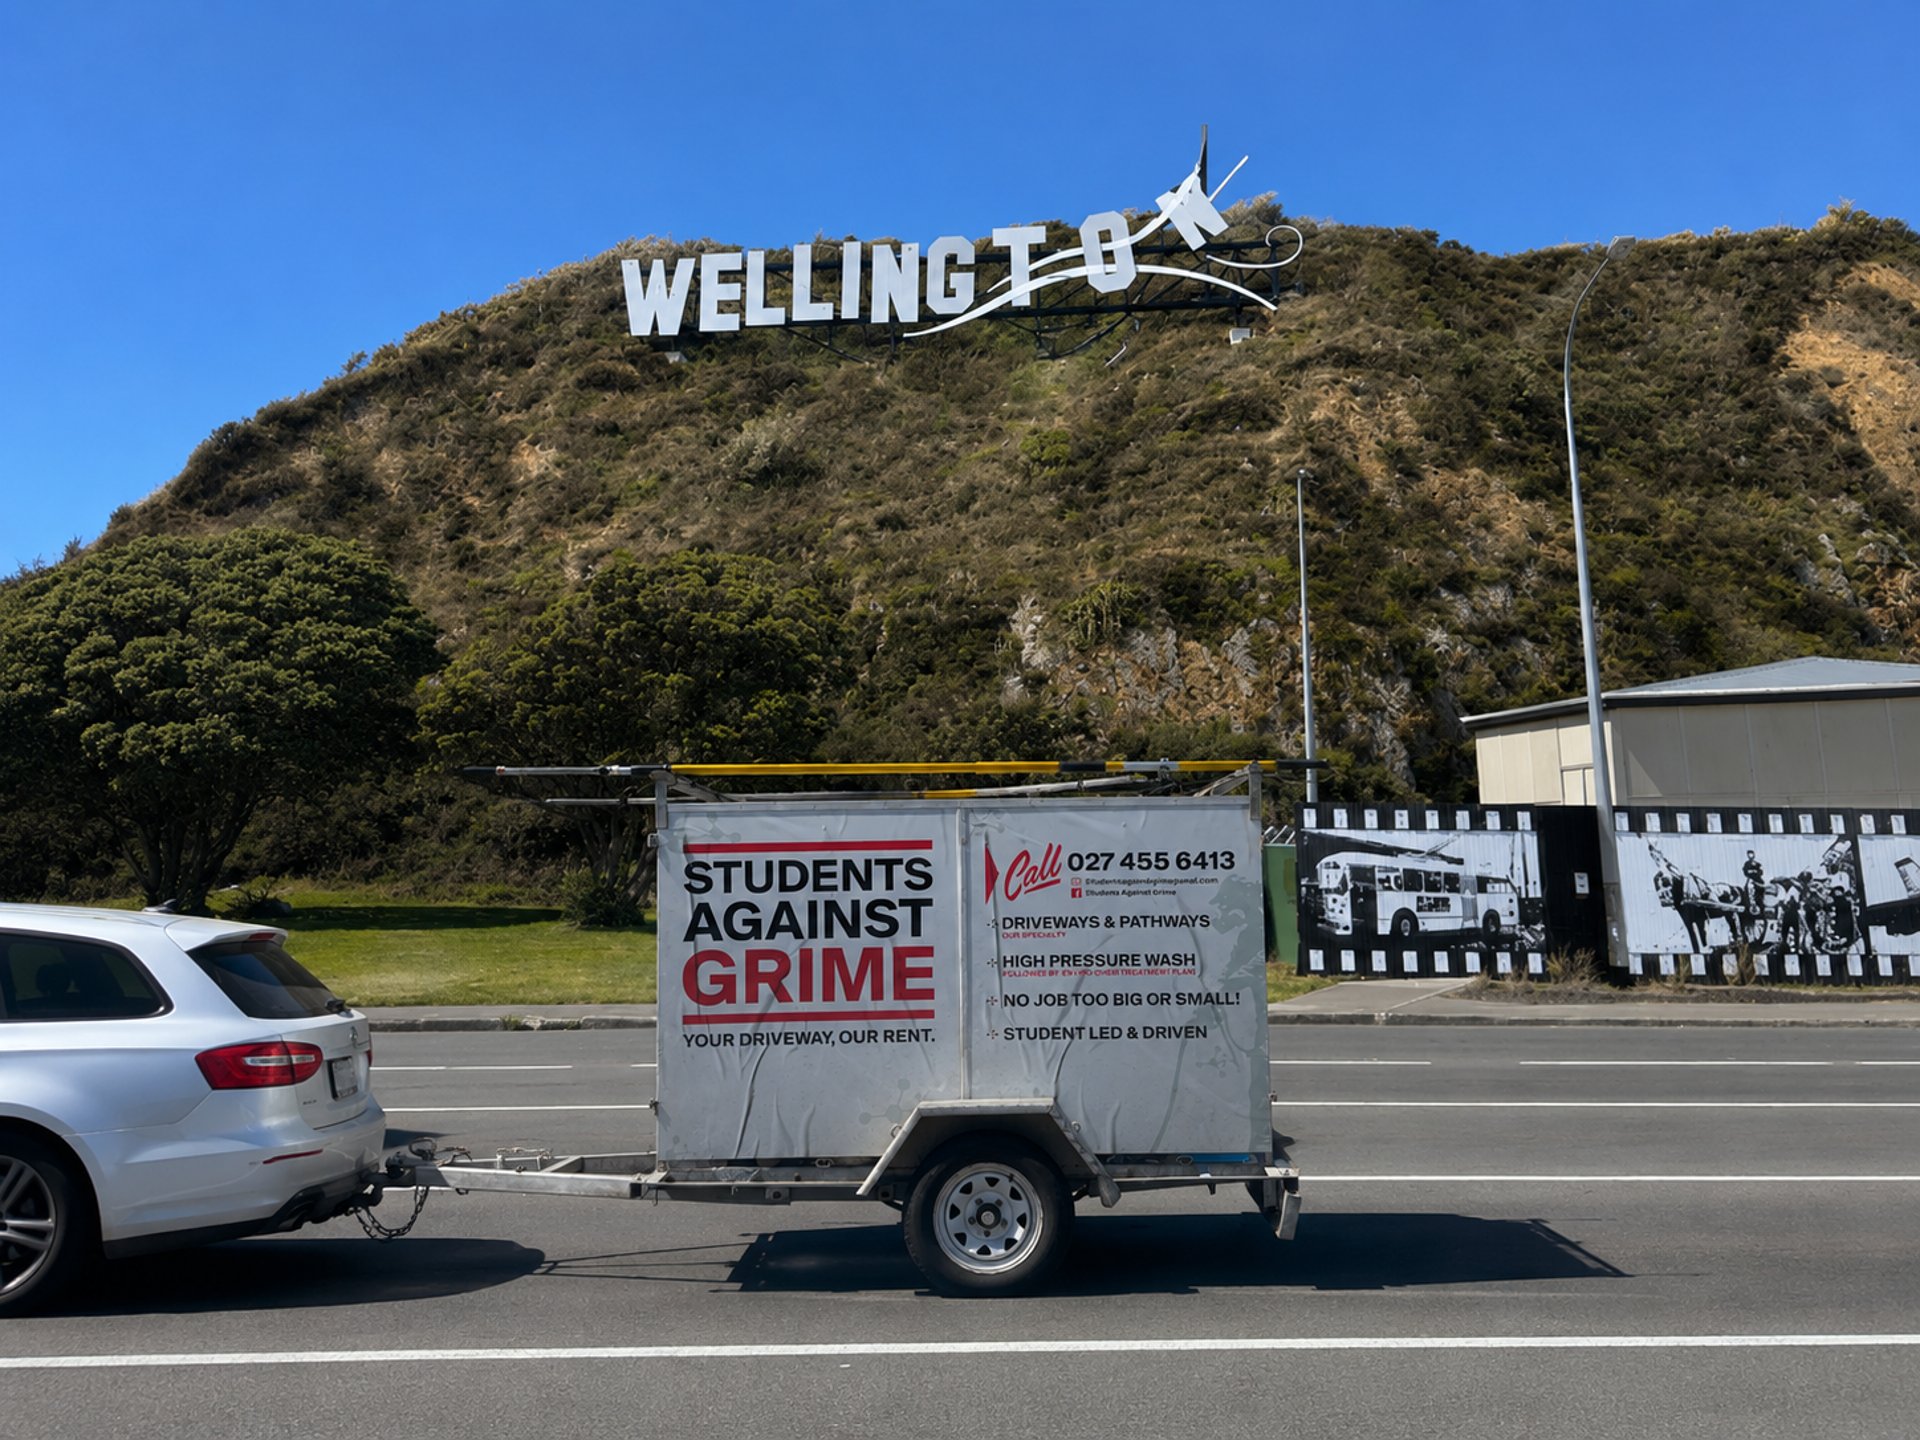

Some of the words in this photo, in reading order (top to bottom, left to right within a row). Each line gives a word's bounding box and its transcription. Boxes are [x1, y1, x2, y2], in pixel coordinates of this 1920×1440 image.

[683, 857, 933, 894] STUDENTS
[1004, 842, 1062, 901] Call
[1067, 852, 1115, 871] 027
[1120, 851, 1170, 871] 455
[1175, 850, 1235, 870] 6413
[683, 898, 933, 942] AGAINST
[1002, 916, 1100, 930] DRIVEWAYS
[1104, 915, 1116, 929] &
[1120, 914, 1211, 928] PATHWAYS
[1003, 954, 1045, 968] HIGH
[1049, 953, 1141, 967] PRESSURE
[1144, 953, 1196, 966] WASH
[682, 946, 935, 1007] GRIME
[1003, 994, 1030, 1008] NO
[1033, 993, 1068, 1007] JOB
[1072, 993, 1109, 1007] TOO
[1113, 992, 1143, 1006] BIG
[1146, 992, 1172, 1006] OR
[1175, 991, 1241, 1006] SMALL!
[683, 1033, 735, 1048] YOUR
[739, 1030, 835, 1047] DRIVEWAY,
[839, 1029, 878, 1044] OUR
[883, 1028, 936, 1043] RENT.
[1003, 1027, 1086, 1041] STUDENT
[1089, 1026, 1123, 1040] LED
[1126, 1026, 1139, 1040] &
[1143, 1025, 1208, 1039] DRIVEN
